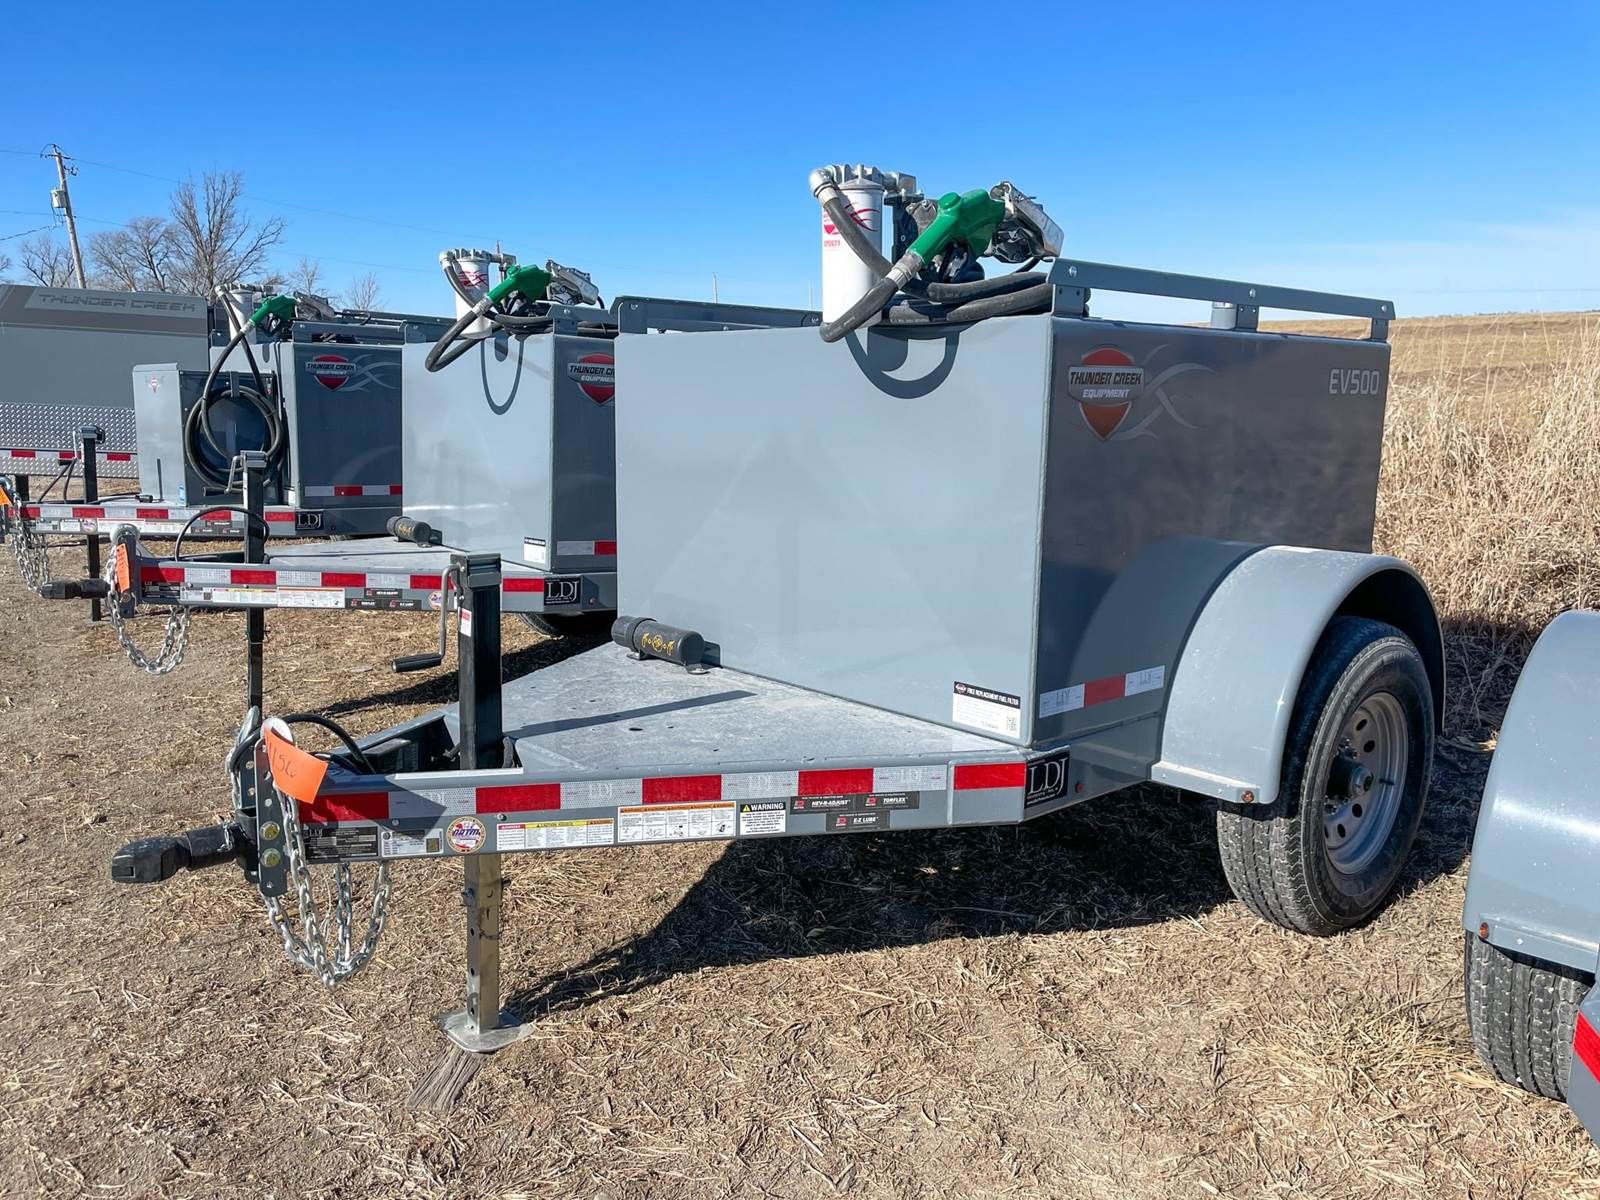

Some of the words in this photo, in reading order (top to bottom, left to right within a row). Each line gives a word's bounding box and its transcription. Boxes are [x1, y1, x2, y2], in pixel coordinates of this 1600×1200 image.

[38, 294, 126, 308] THUNDER
[130, 300, 196, 312] CREEK
[569, 365, 605, 375] THUNDER
[1070, 371, 1112, 385] THUNDER
[1113, 372, 1142, 385] CREEK
[1328, 368, 1380, 395] EV500
[1082, 388, 1130, 399] EQUIPMENT
[297, 513, 322, 529] LDJ
[546, 580, 580, 602] LDJ
[1028, 757, 1069, 796] LDJ
[750, 802, 784, 811] WARNING
